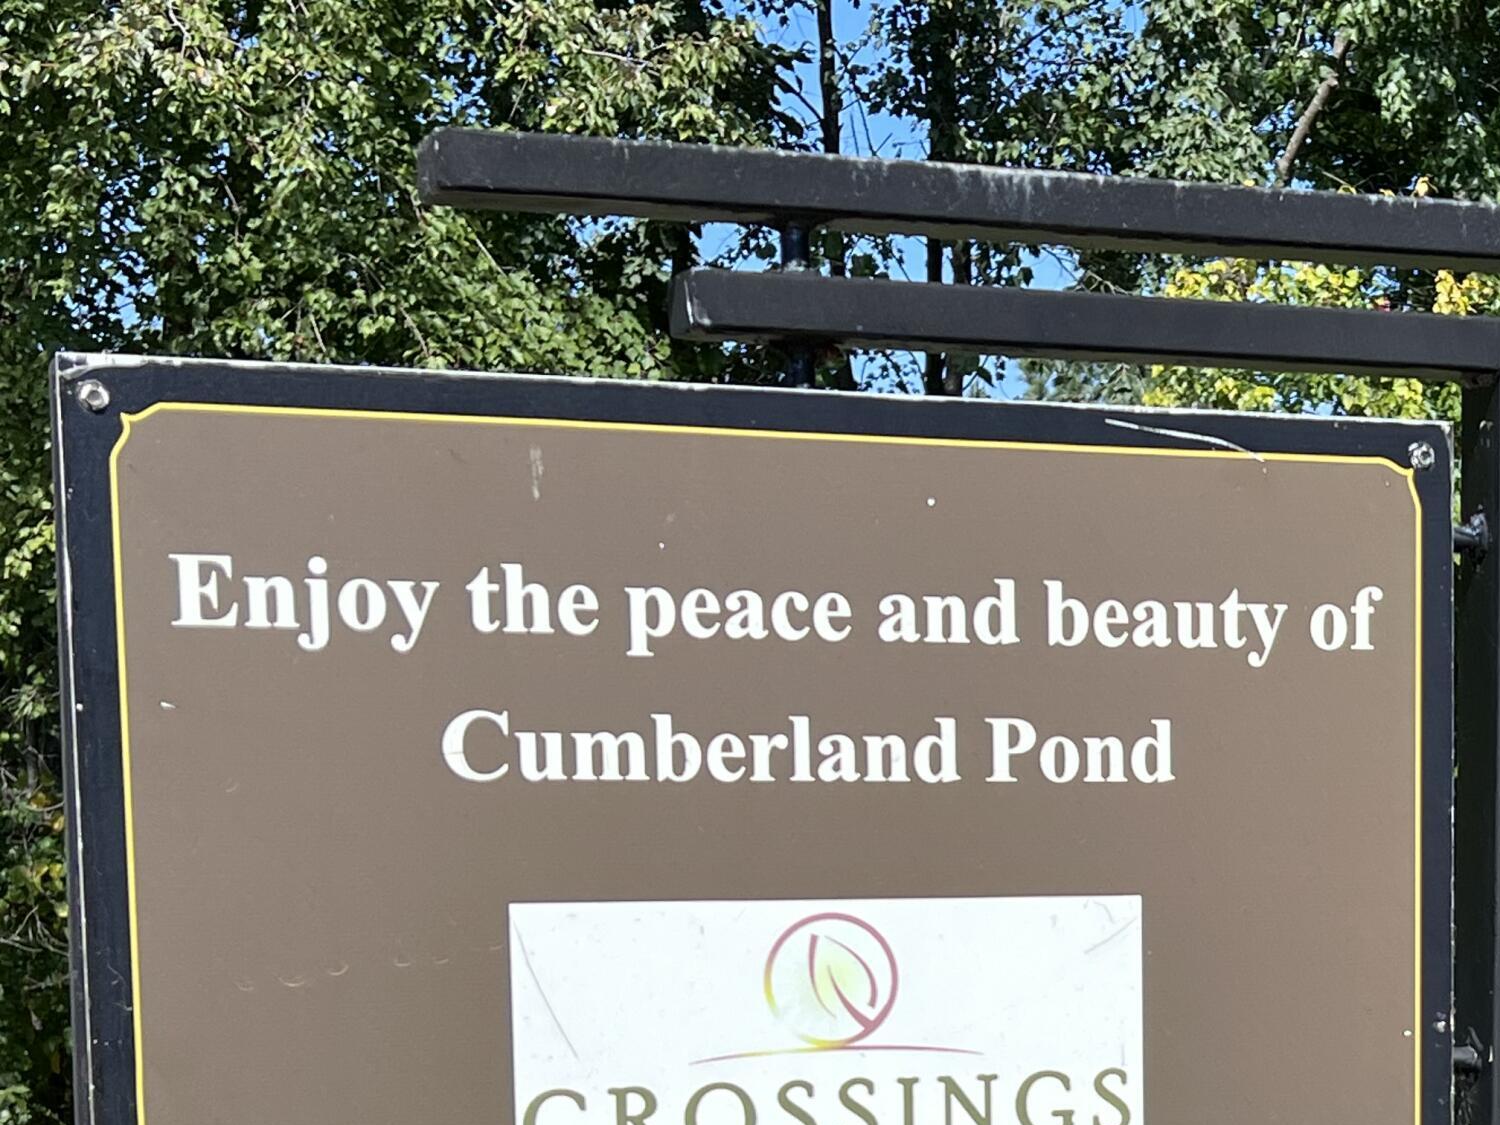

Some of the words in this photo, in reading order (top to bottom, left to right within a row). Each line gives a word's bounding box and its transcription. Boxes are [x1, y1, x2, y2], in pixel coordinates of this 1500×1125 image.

[168, 553, 440, 652] Enjoy
[465, 563, 599, 636] the
[624, 586, 852, 657] peace
[878, 578, 1021, 645] and
[1043, 579, 1289, 668] beauty
[1310, 586, 1384, 651] of
[442, 709, 961, 784] Cumberland
[984, 717, 1176, 784] Pond
